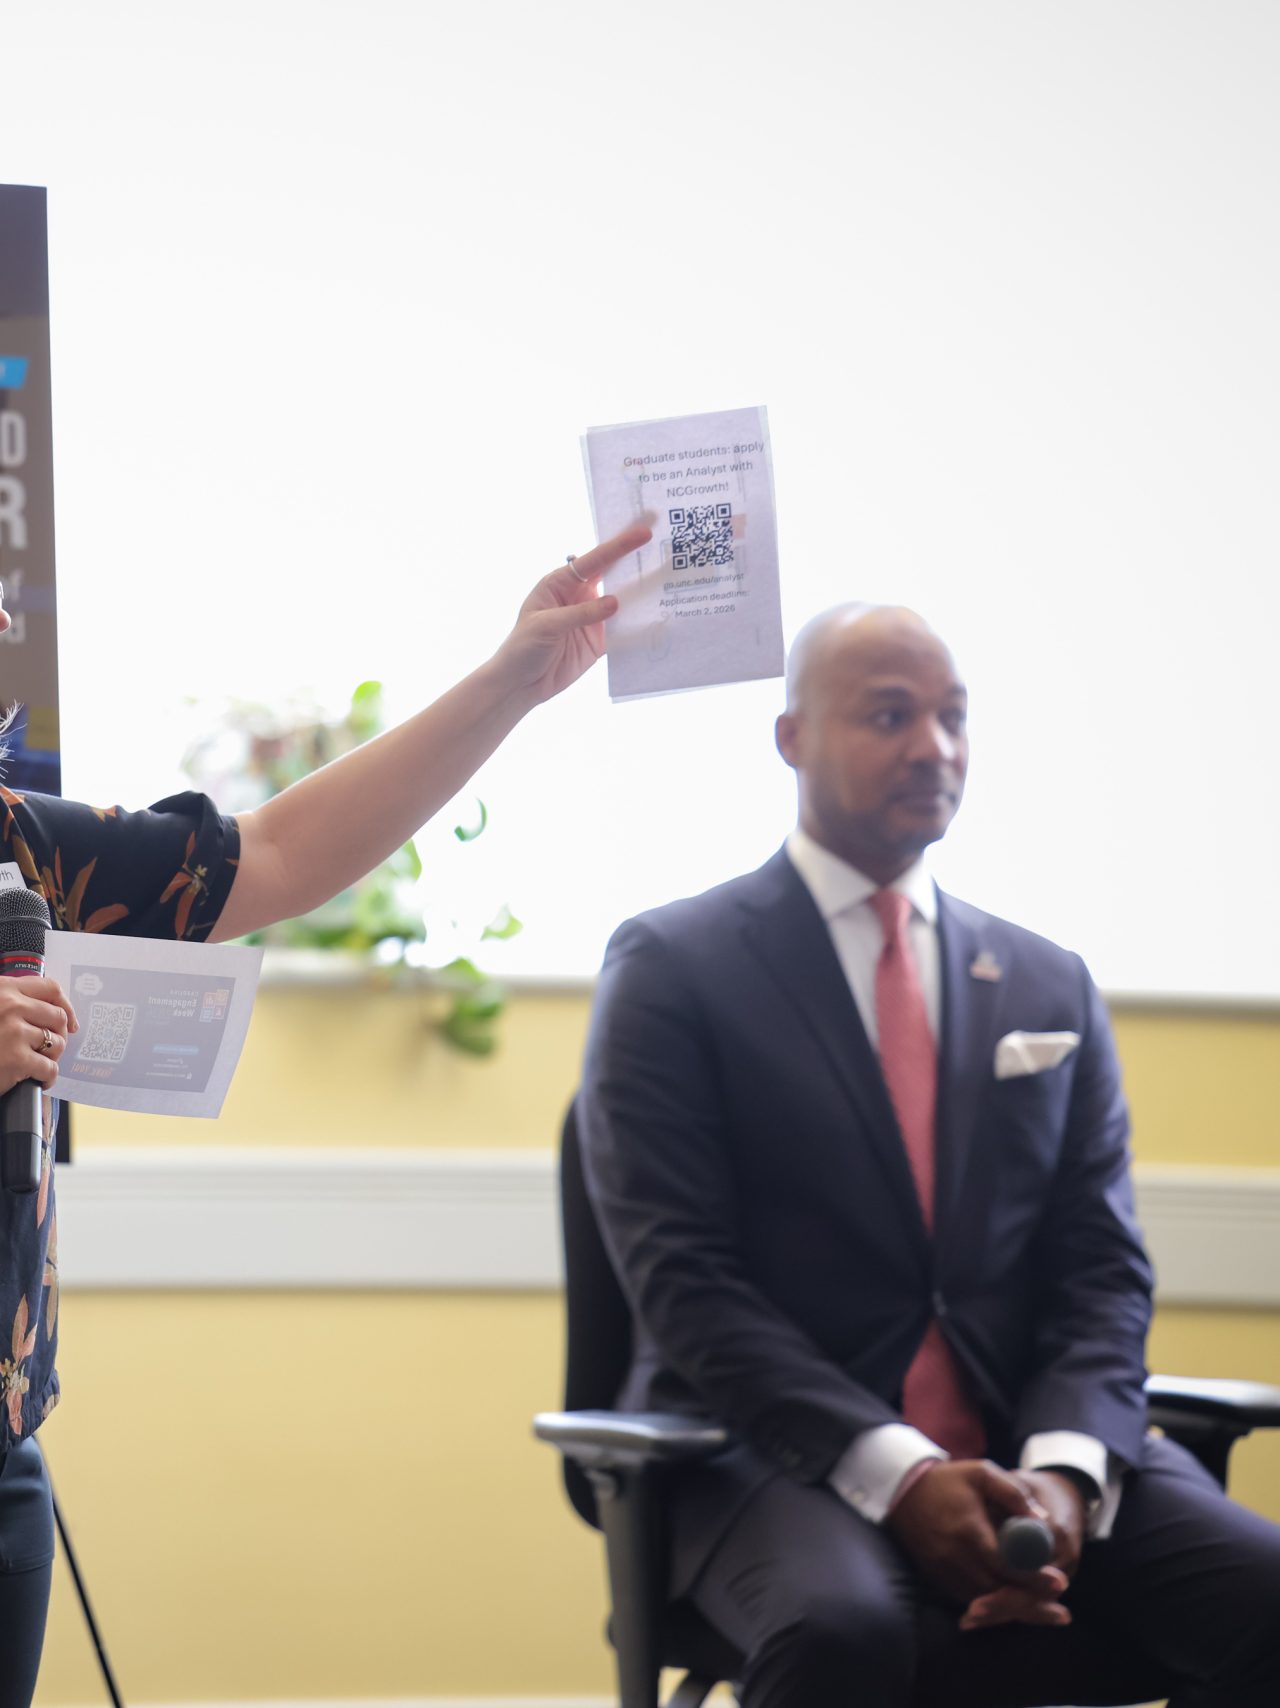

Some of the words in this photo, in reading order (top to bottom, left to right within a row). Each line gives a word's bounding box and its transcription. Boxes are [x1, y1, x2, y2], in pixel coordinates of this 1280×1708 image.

[624, 452, 676, 467] Graduate
[678, 446, 731, 460] students:
[733, 441, 765, 455] apply
[638, 474, 650, 483] to
[653, 472, 667, 482] be
[670, 471, 683, 480] an
[686, 464, 726, 478] Analyst
[730, 461, 753, 472] with
[667, 482, 729, 498] NCGrowth!
[660, 594, 708, 607] Application
[675, 608, 702, 618] March
[704, 607, 712, 616] 2,
[714, 604, 735, 614] 2026
